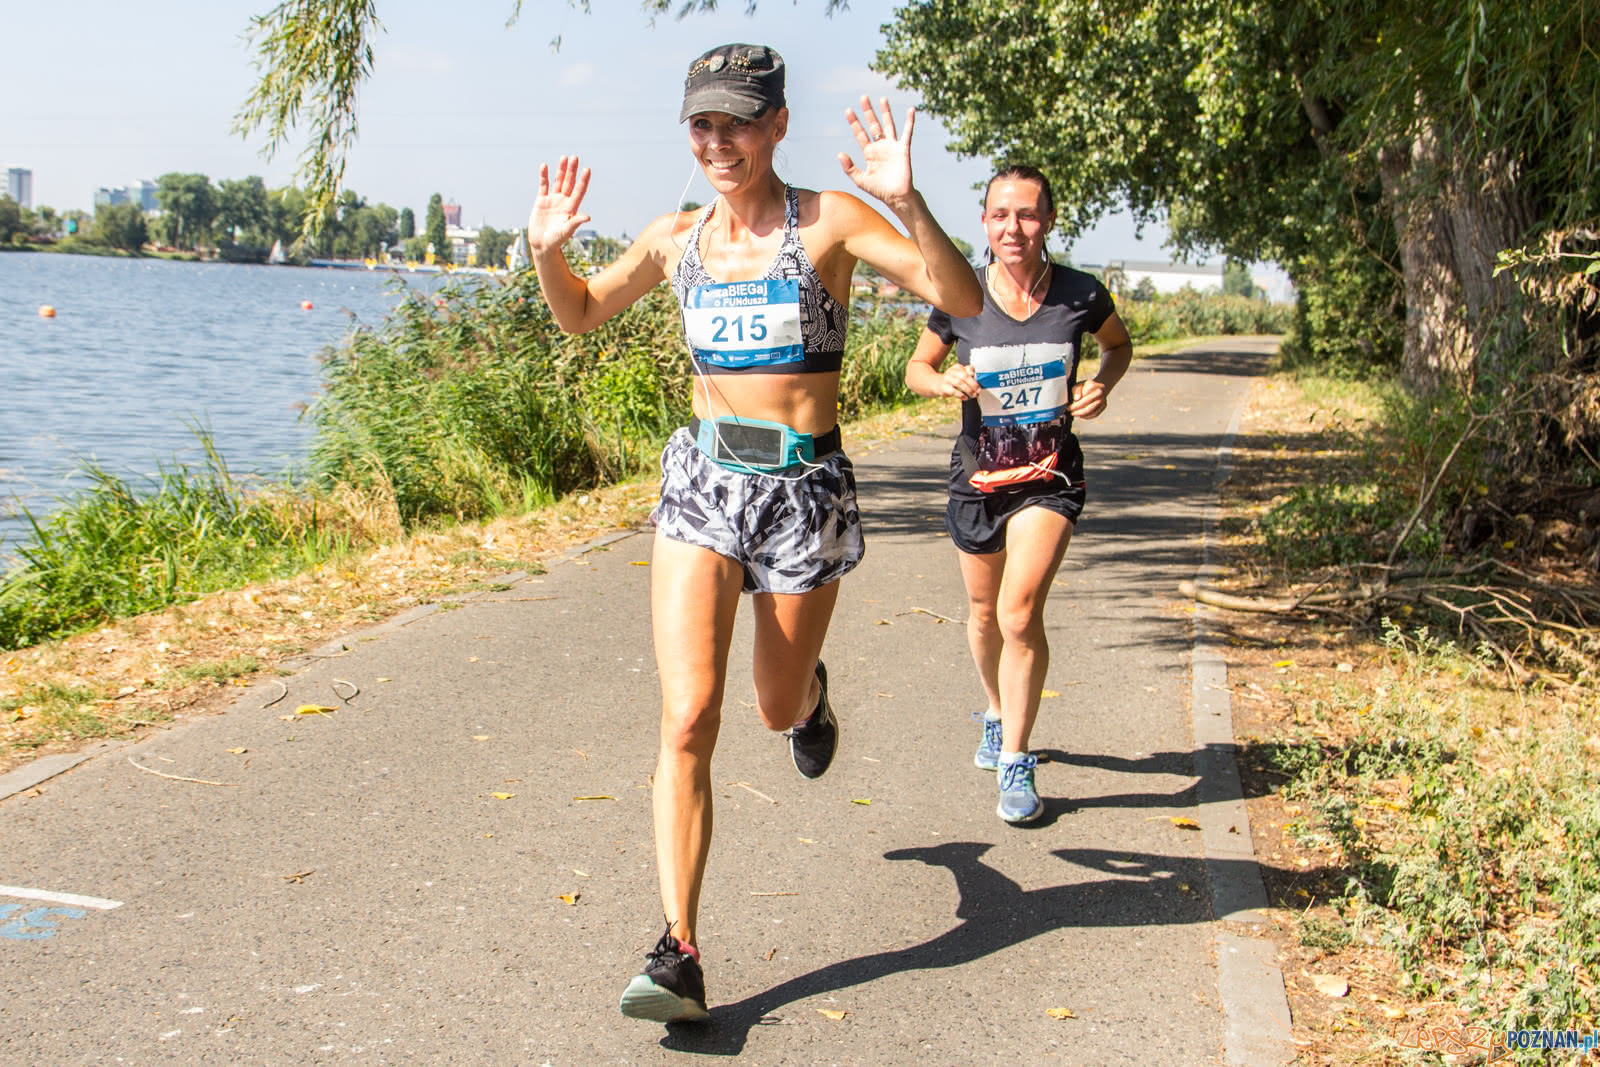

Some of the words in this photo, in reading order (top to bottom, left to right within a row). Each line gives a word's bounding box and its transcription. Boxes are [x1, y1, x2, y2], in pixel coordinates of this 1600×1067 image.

[723, 296, 768, 306] FUNdusze
[711, 313, 767, 343] 215
[999, 366, 1043, 381] zaBIEGaj
[1000, 386, 1042, 410] 247
